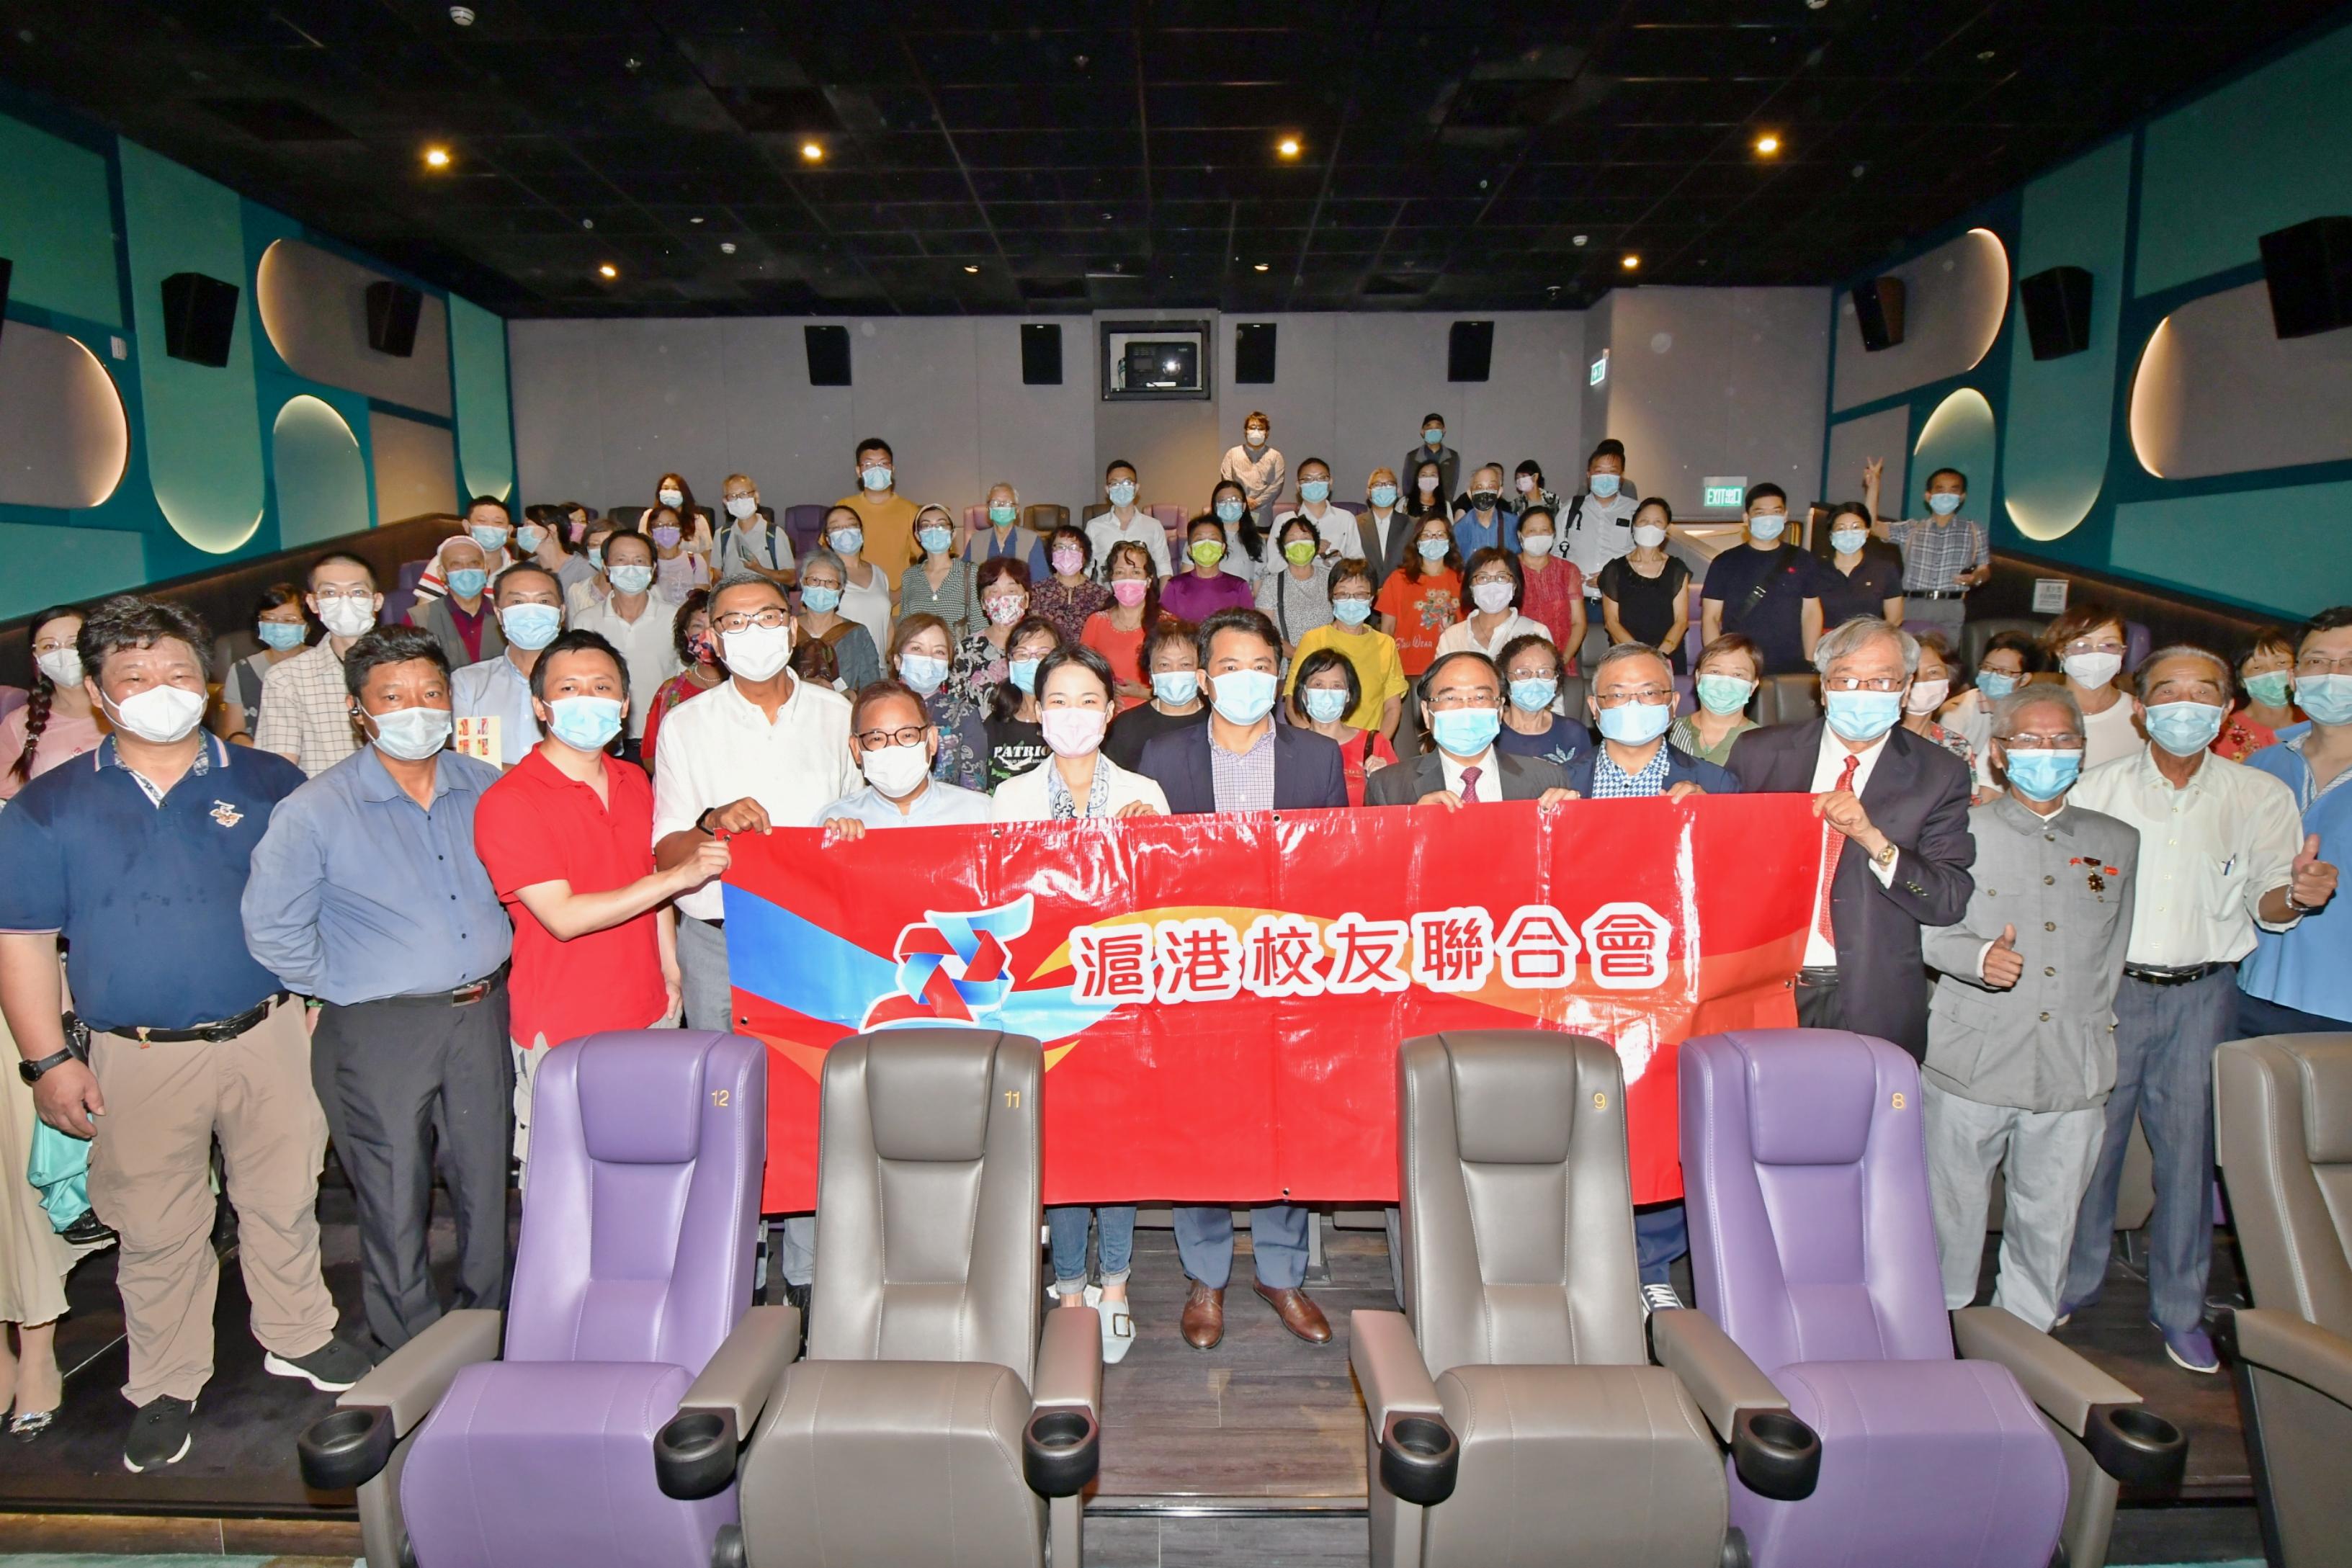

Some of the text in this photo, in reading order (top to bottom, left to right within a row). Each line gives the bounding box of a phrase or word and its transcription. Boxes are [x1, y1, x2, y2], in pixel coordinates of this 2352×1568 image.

[1707, 489, 1726, 504] EXIT
[1080, 913, 1660, 998] 滬港校友聯合會
[712, 1090, 728, 1106] 12
[1005, 1090, 1019, 1108] 11
[1594, 1093, 1605, 1108] 9
[1892, 1093, 1904, 1108] 8
